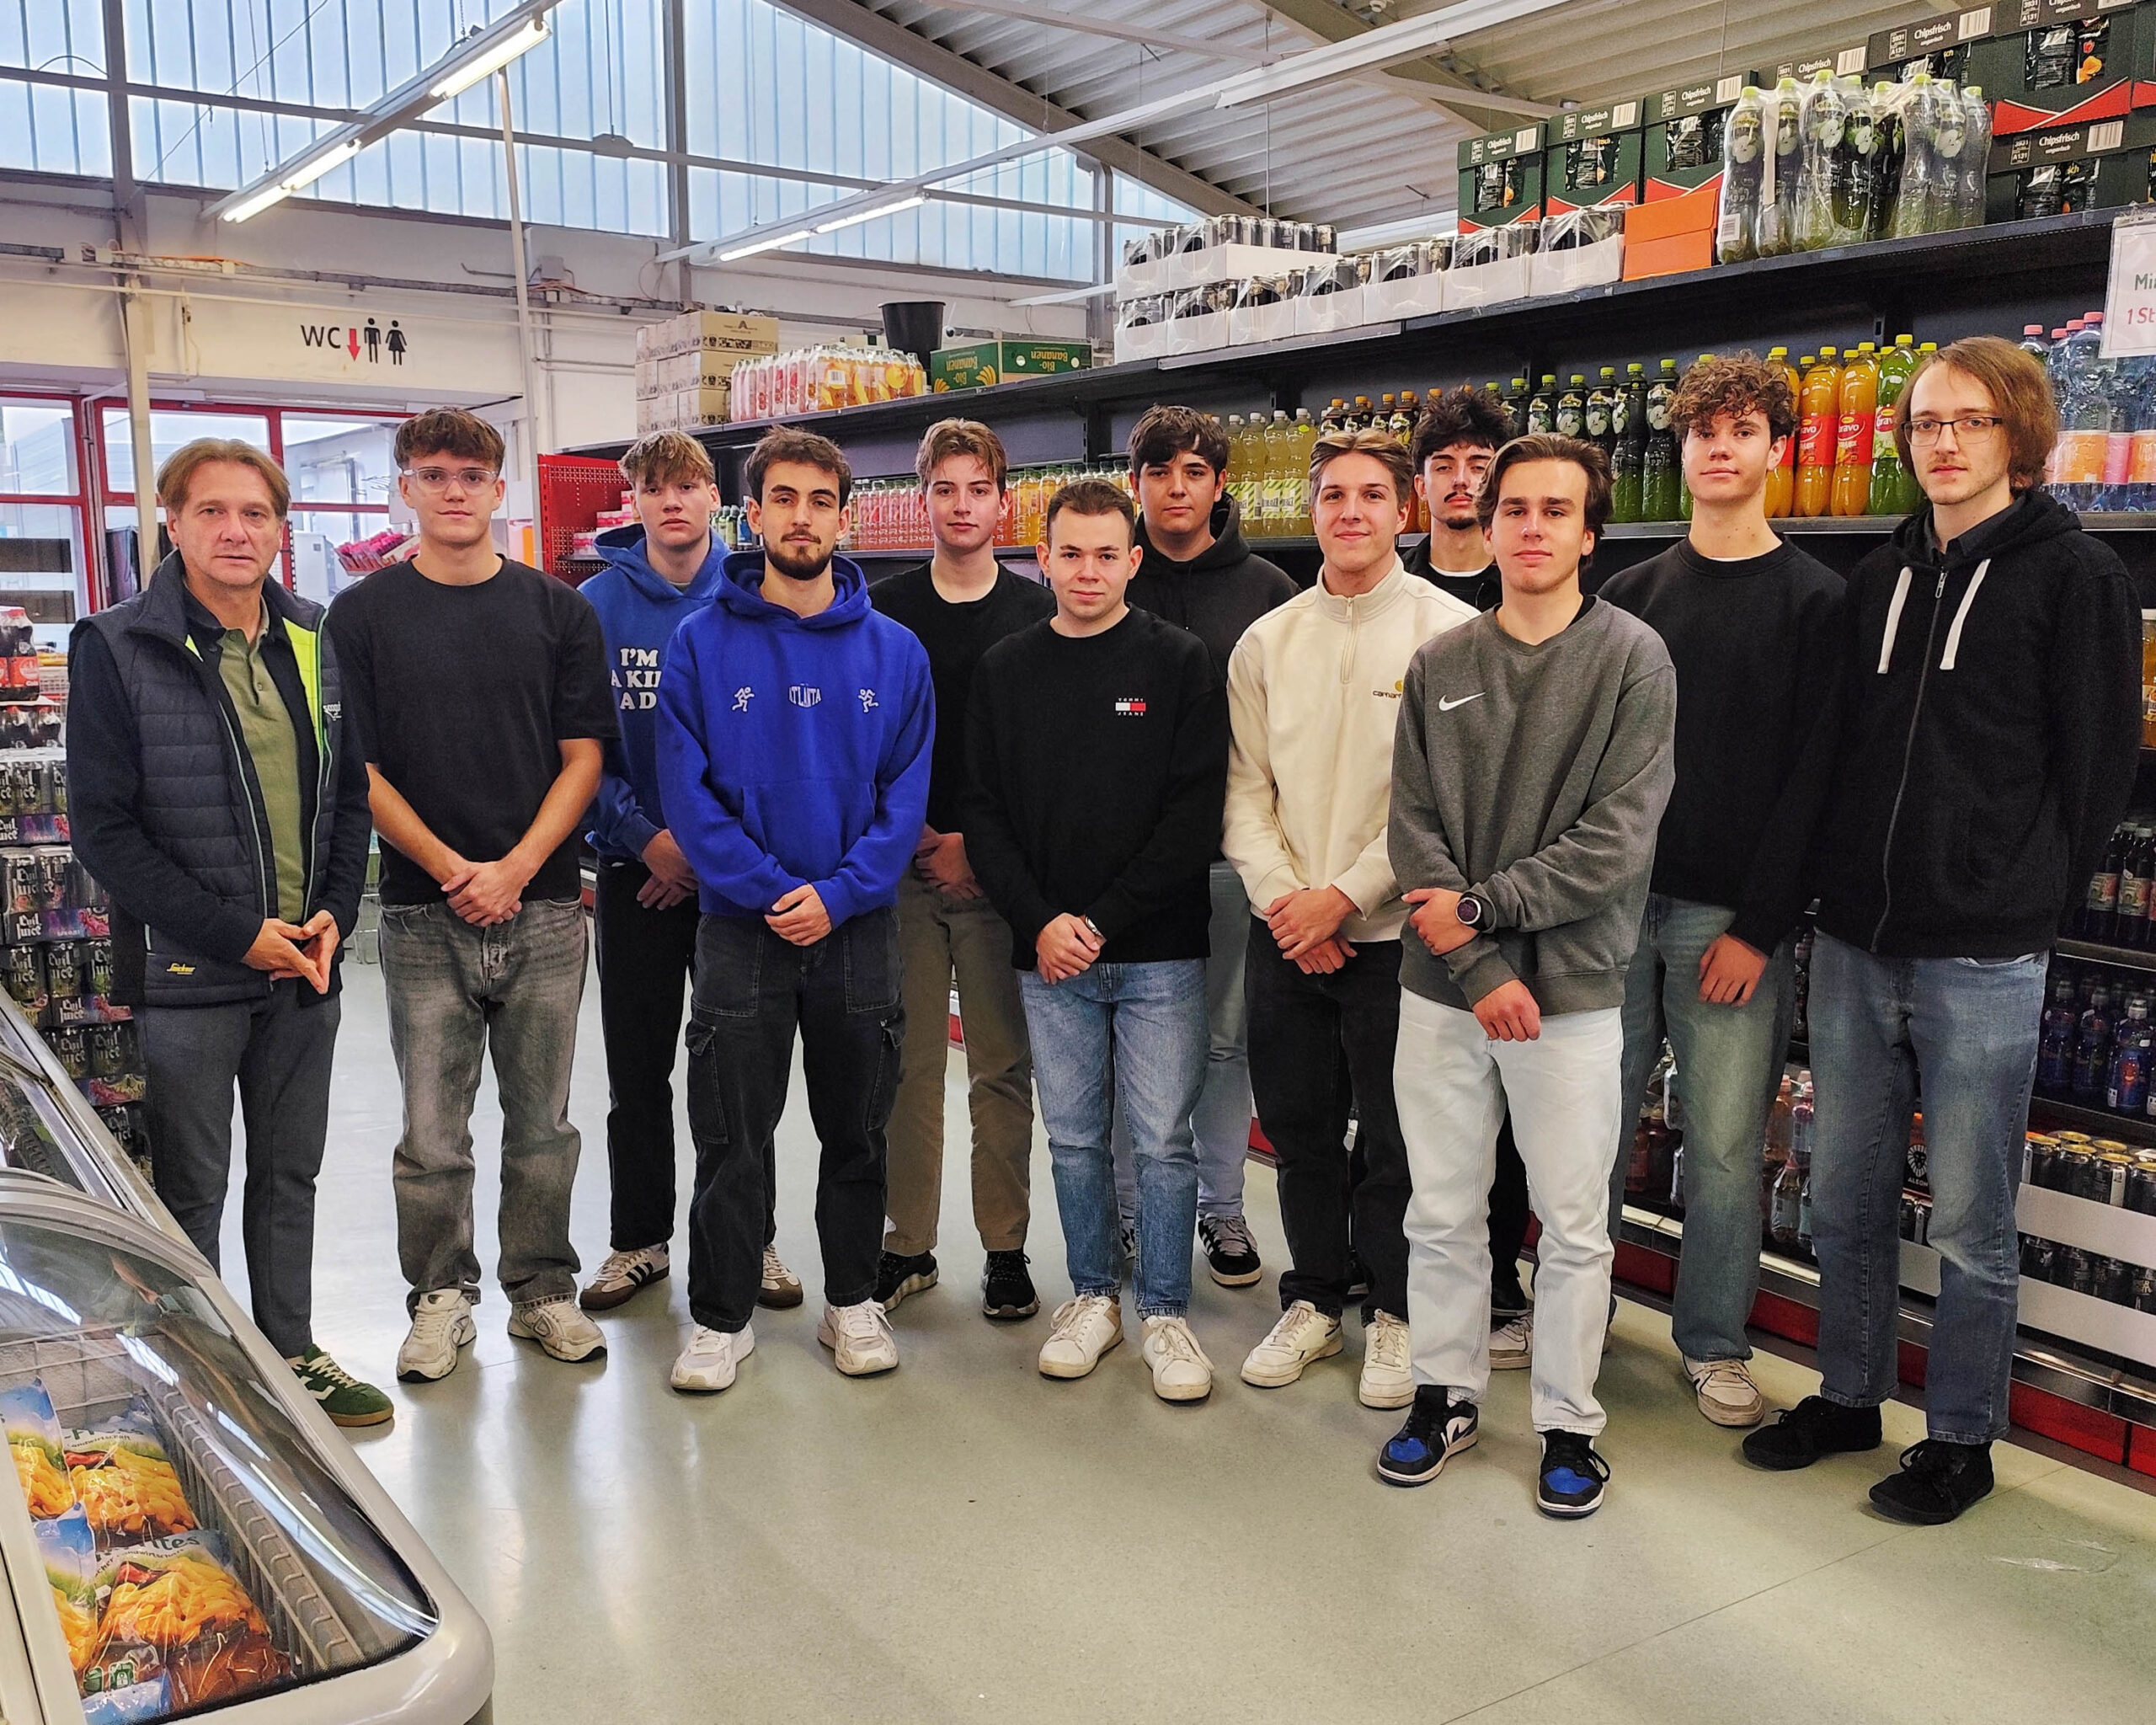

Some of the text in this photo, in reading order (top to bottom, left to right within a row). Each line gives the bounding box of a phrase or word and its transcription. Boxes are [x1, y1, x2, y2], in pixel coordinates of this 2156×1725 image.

[1913, 21, 1952, 40] Chipsfrisch
[1798, 57, 1832, 73] Chipsfrisch
[1681, 86, 1711, 100] Chipsfrisch
[1582, 110, 1609, 124] Chipsfrisch
[1487, 136, 1513, 149] Chipsfrisch
[2039, 131, 2080, 147] Chipsfrisch
[2134, 274, 2156, 291] Mi
[2127, 308, 2133, 324] 1
[301, 325, 341, 349] WC
[946, 355, 979, 371] Bananen
[1031, 350, 1068, 362] Bananen
[1876, 417, 1893, 429] brav
[611, 669, 622, 687] A
[789, 683, 822, 708] ATLANTA
[19, 913, 42, 927] Evil
[16, 923, 42, 940] Juice
[48, 950, 73, 969] Evil
[62, 997, 85, 1012] Evil
[60, 1007, 85, 1024] Juice
